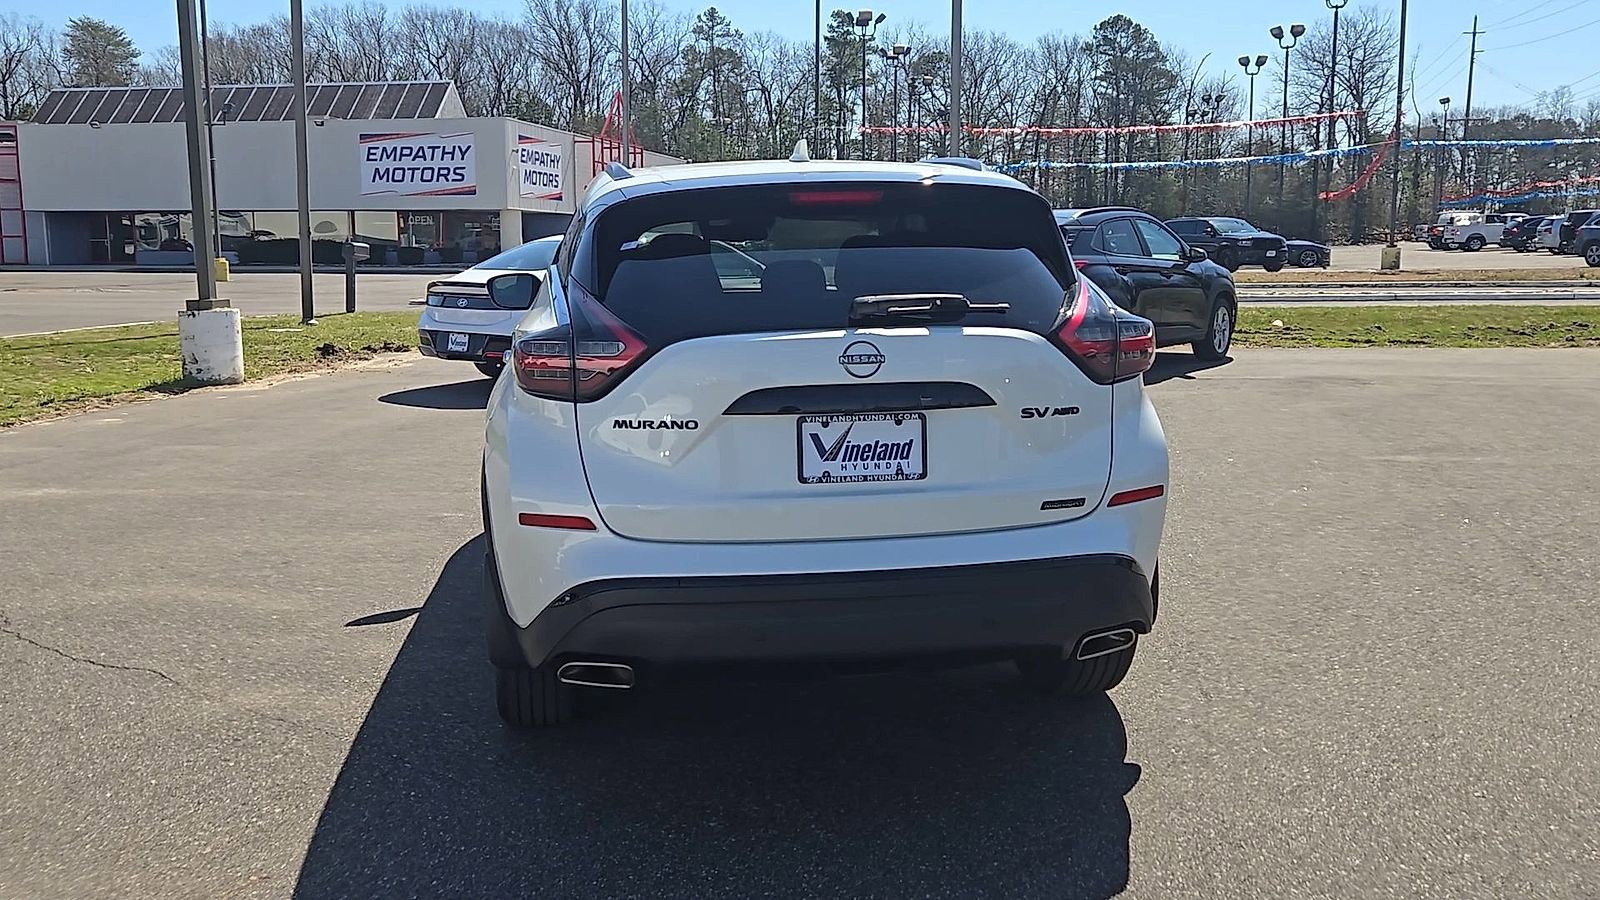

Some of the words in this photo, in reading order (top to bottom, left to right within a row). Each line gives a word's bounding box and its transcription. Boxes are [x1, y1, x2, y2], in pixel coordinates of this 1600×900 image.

[366, 145, 472, 162] EMPATHY
[520, 148, 561, 170] EMPATHY
[371, 166, 466, 183] MOTORS
[523, 170, 560, 188] MOTORS
[408, 215, 434, 225] OPEN
[839, 355, 885, 363] NISSAN
[1020, 407, 1050, 418] SV
[1051, 406, 1080, 416] AWD
[805, 413, 919, 423] VINELANDHYUNDAI.COM
[612, 419, 699, 430] MURANO
[808, 421, 914, 463] Vineland
[840, 461, 911, 471] HYUNDAI
[821, 475, 864, 483] VINELAND
[867, 473, 906, 481] HYUNDAI
